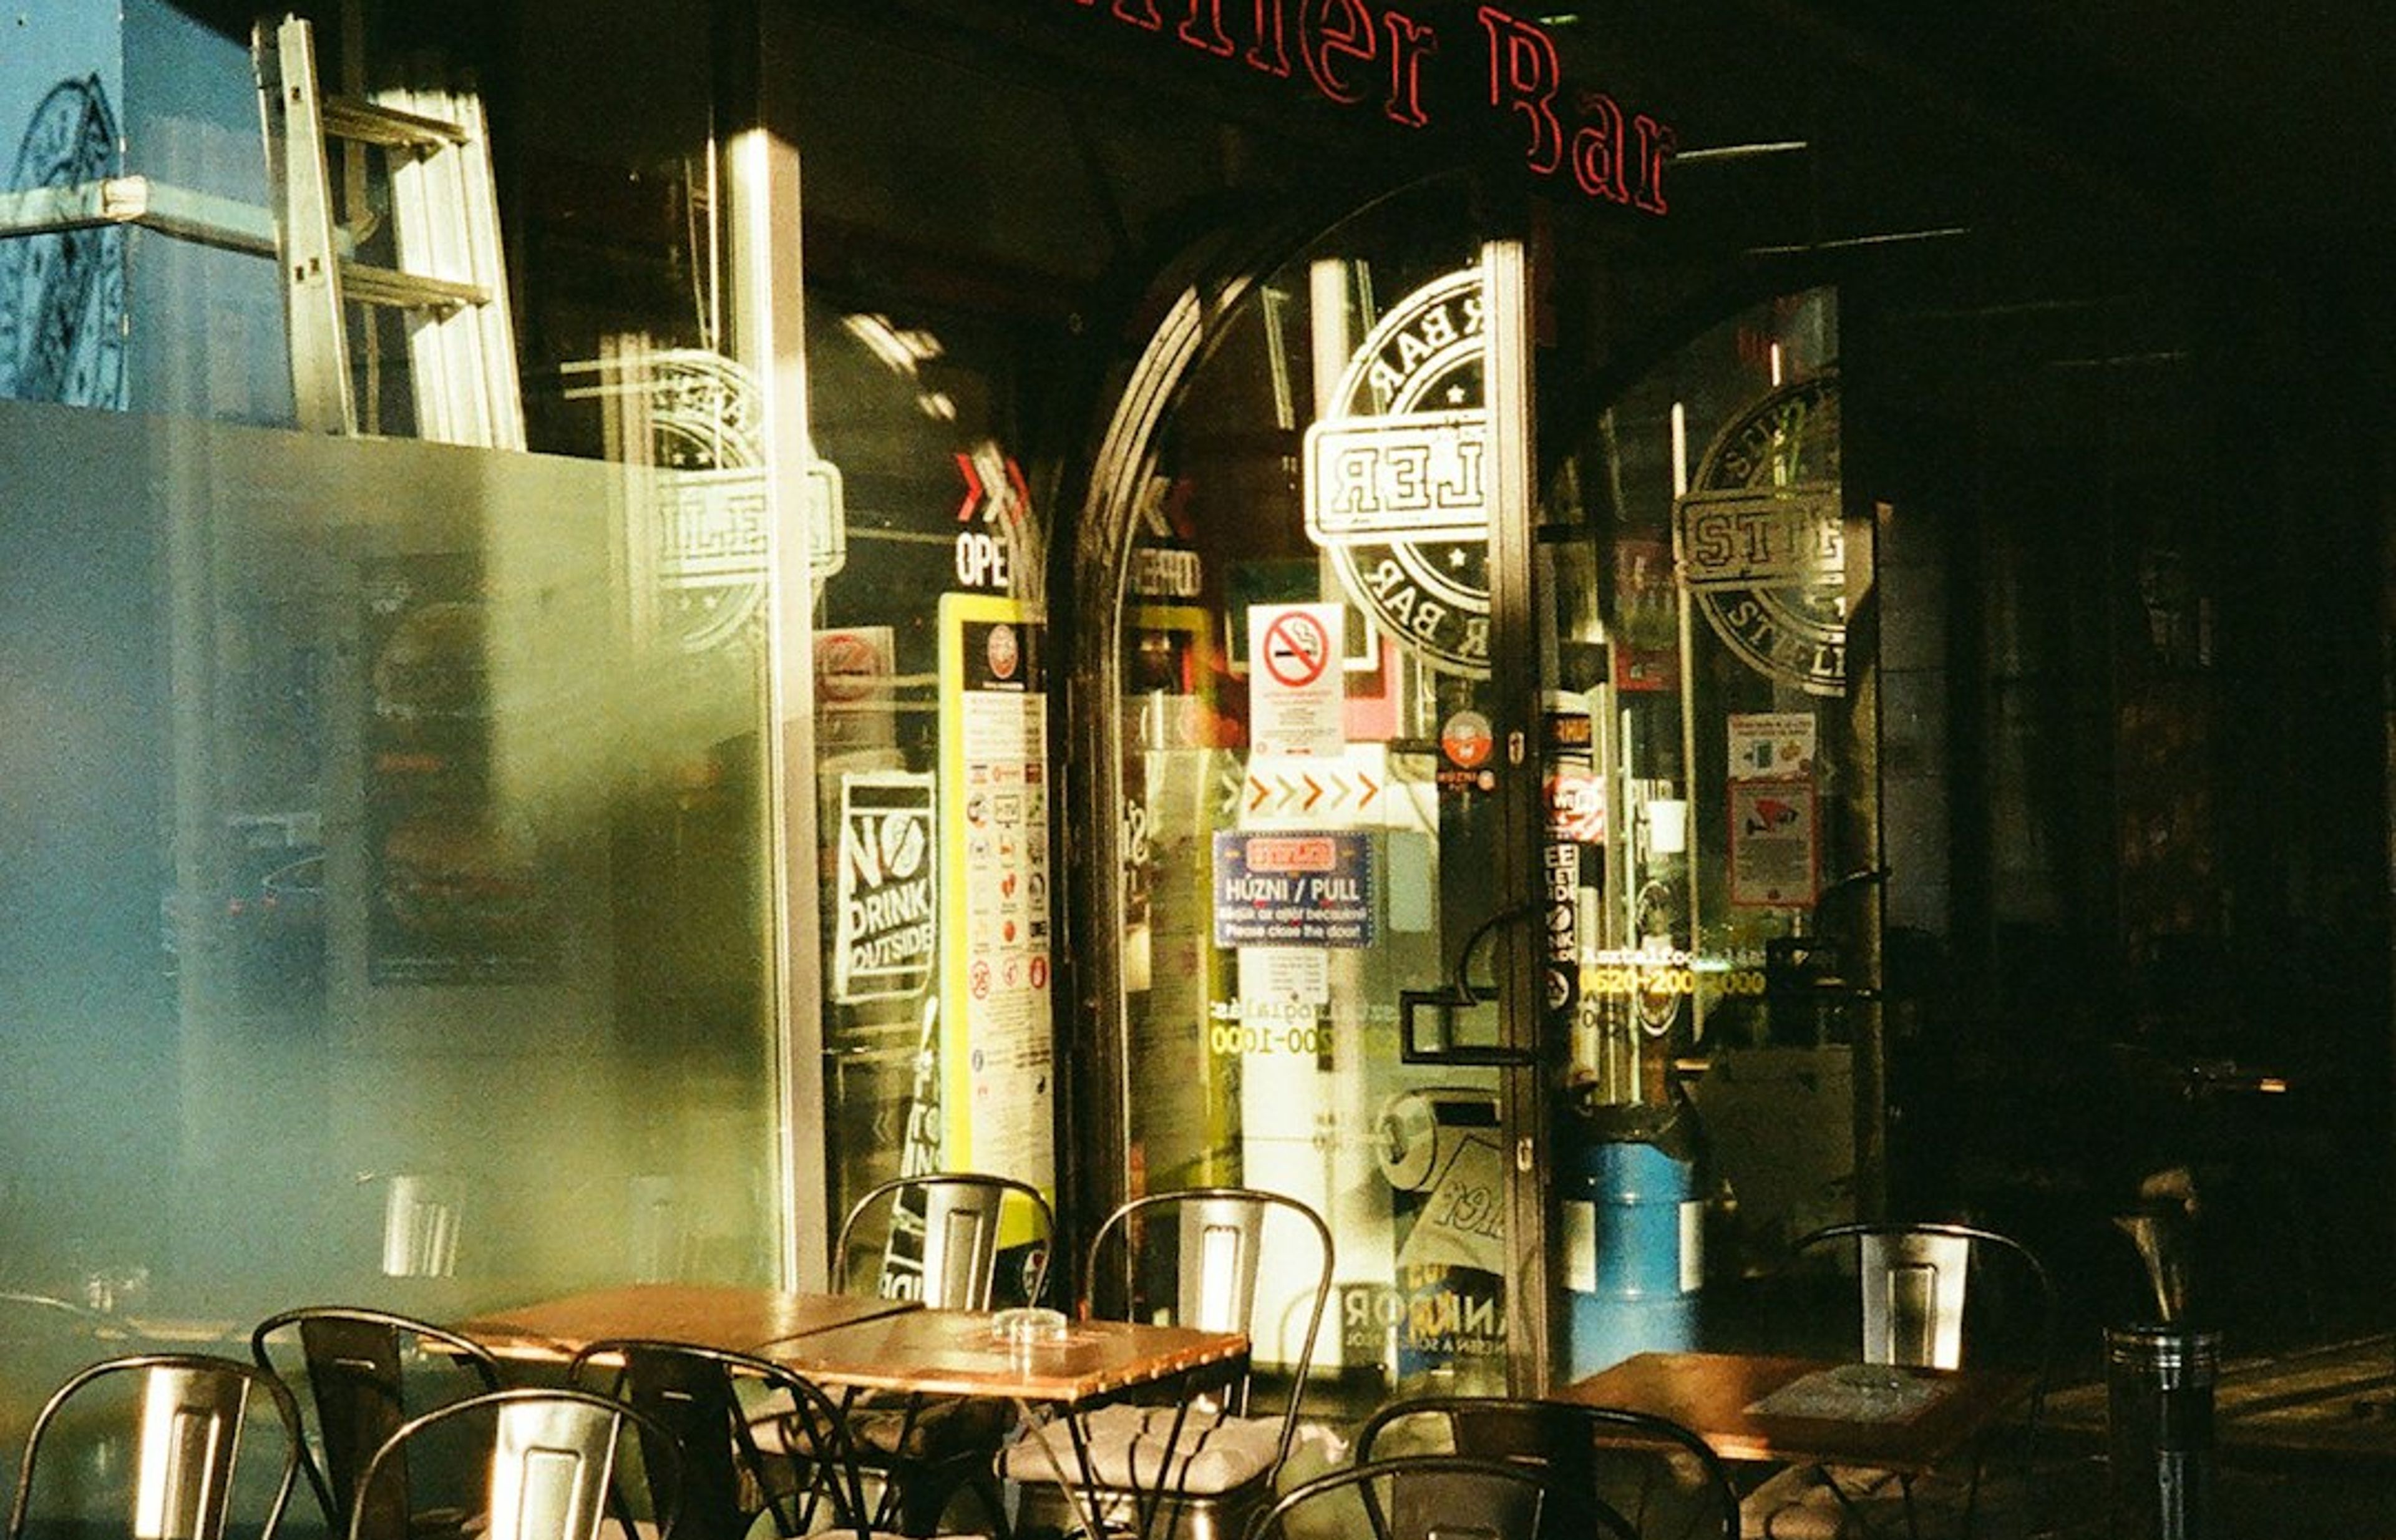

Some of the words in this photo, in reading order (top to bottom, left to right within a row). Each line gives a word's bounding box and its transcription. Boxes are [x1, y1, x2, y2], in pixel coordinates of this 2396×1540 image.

[1478, 6, 1677, 216] Bar
[850, 878, 930, 940] DRINK
[1225, 874, 1289, 901] HÚZNI
[1310, 879, 1360, 901] PULL
[851, 924, 934, 969] OUTSIDE
